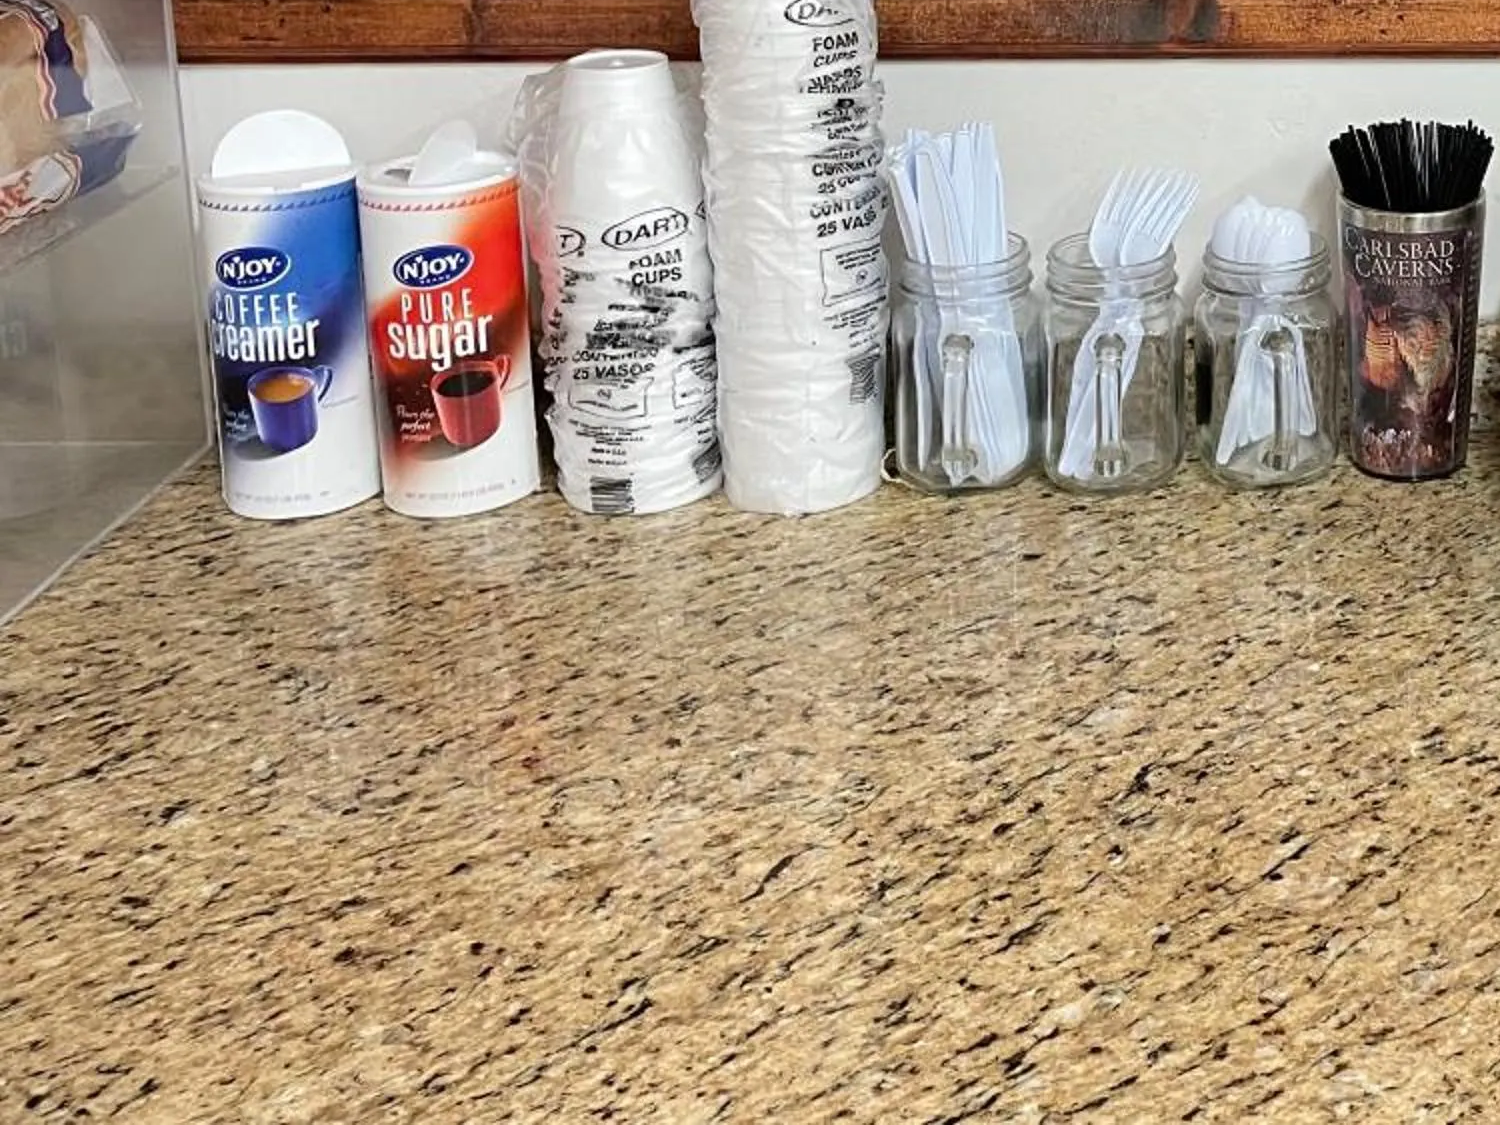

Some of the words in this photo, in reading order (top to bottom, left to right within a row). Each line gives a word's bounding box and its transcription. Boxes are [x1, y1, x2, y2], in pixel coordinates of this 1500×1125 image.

[811, 30, 859, 52] FOAM
[614, 214, 680, 246] DART
[816, 220, 838, 238] 25
[1345, 226, 1455, 260] CARLSBAD
[629, 248, 683, 270] FOAM
[1355, 252, 1454, 277] CAVERNS
[631, 266, 683, 287] CUPS
[215, 291, 300, 325] COFFEE
[401, 288, 474, 324] PURE
[212, 318, 320, 362] creamer
[387, 314, 493, 372] sugar
[573, 367, 589, 380] 25
